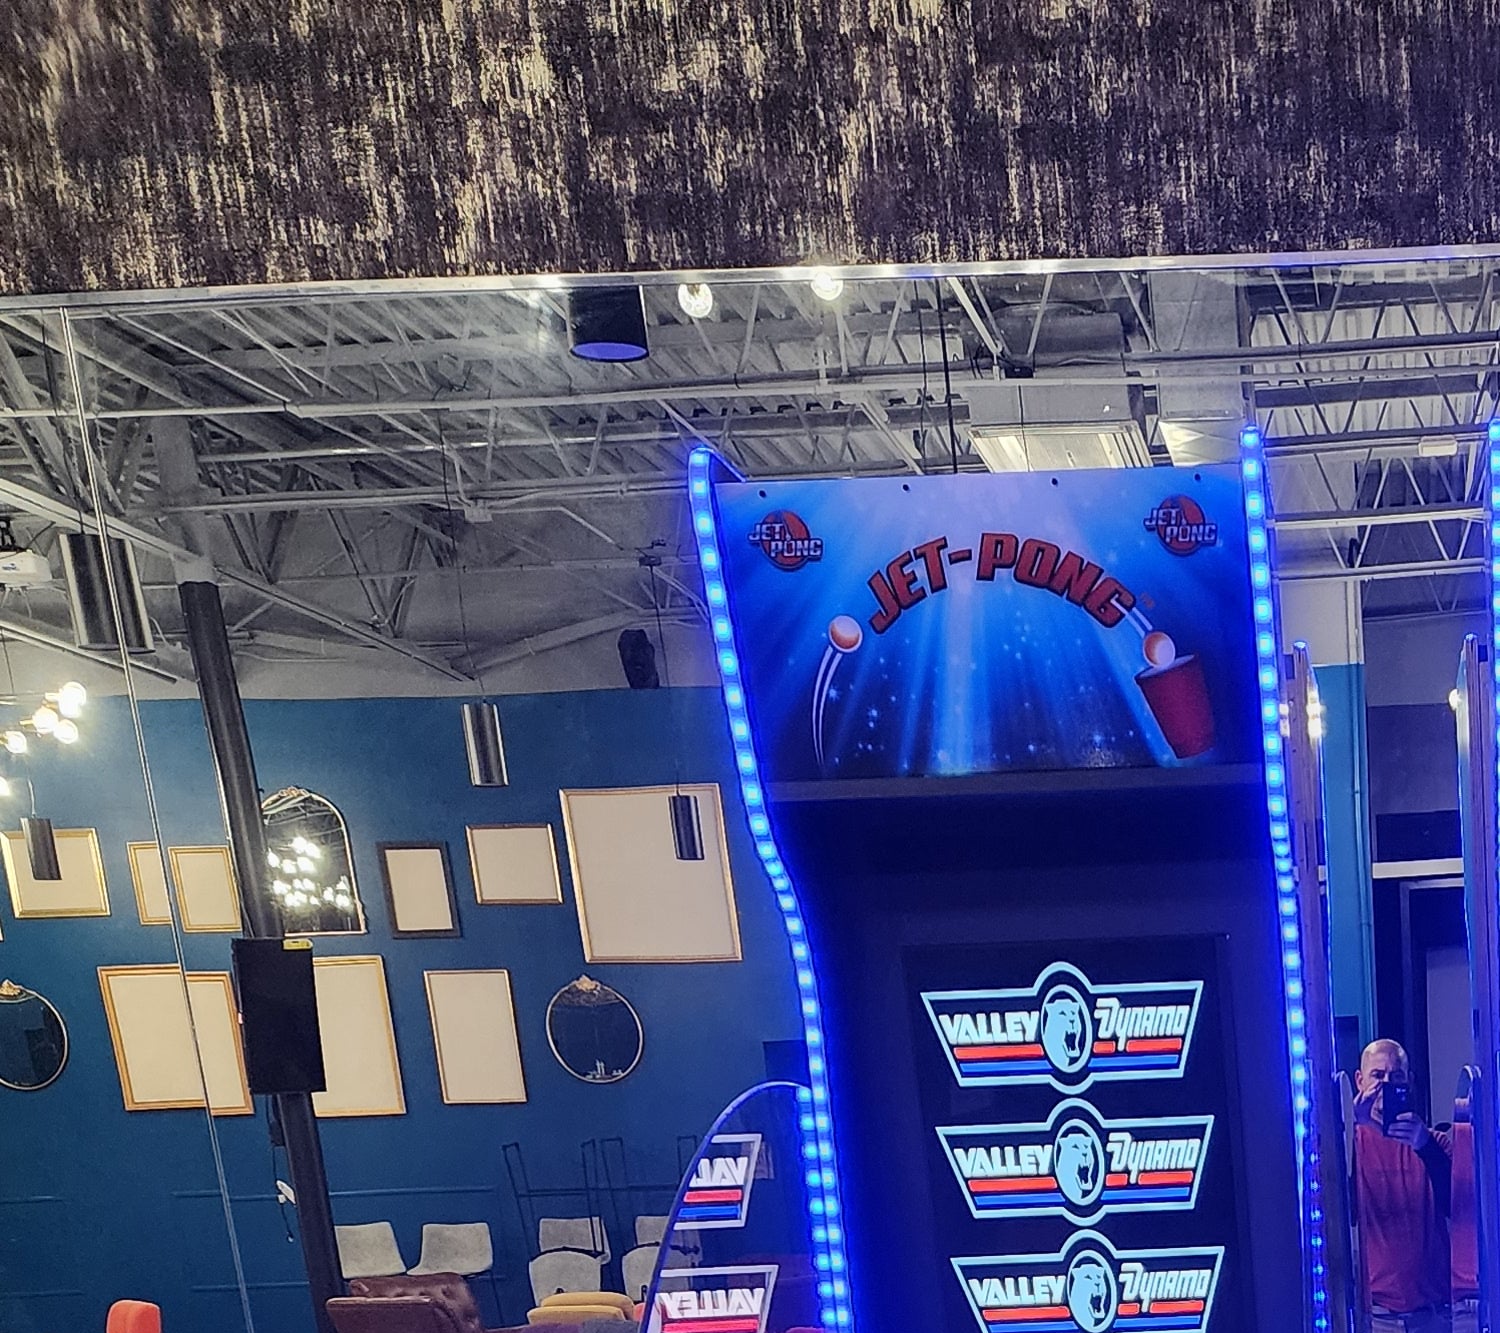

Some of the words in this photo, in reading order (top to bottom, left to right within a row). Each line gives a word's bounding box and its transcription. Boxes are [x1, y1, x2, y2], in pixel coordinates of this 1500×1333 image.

[1143, 507, 1181, 527] JET
[747, 522, 785, 542] JET
[1165, 523, 1217, 544] PONG
[769, 538, 823, 558] PONG
[938, 1010, 1041, 1046] VALLEY
[953, 1144, 1055, 1180] VALLEY
[967, 1275, 1067, 1308] VALLEY
